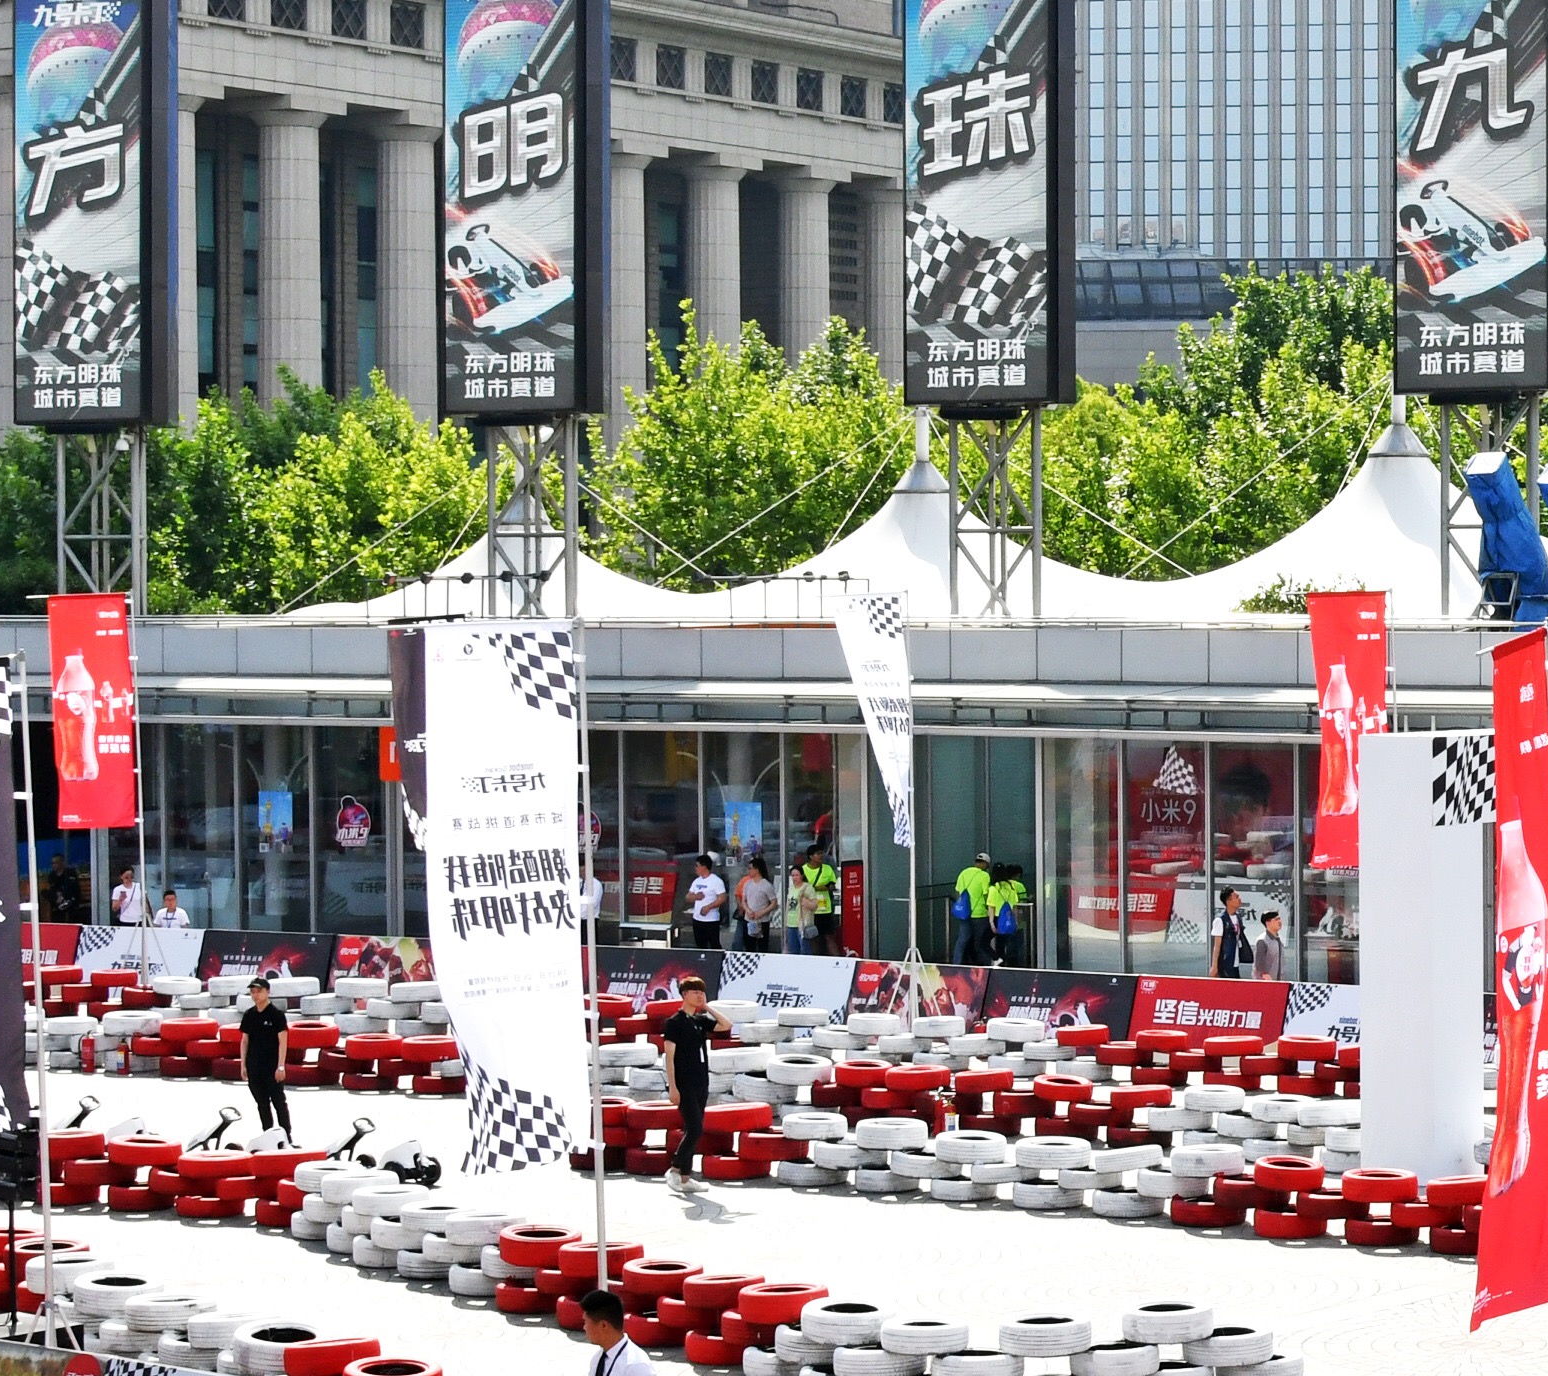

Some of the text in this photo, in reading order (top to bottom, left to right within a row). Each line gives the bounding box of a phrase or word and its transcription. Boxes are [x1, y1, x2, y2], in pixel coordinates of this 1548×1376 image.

[33, 3, 107, 27] 九号卡丁
[1417, 40, 1530, 152] 九
[923, 71, 1031, 176] 珠
[464, 92, 563, 198] 明
[29, 126, 124, 216] 方
[1419, 322, 1525, 347] 东方明珠
[927, 338, 1025, 362] 东方明珠
[34, 364, 122, 385] 东方明珠
[465, 352, 555, 373] 东方明珠
[1419, 350, 1525, 375] 城市赛道
[465, 376, 555, 398] 城市赛道
[927, 364, 1026, 387] 城市赛道
[34, 386, 122, 408] 城市赛道
[1141, 798, 1197, 824] 小米9
[756, 992, 804, 1008] 九号卡丁
[1153, 998, 1262, 1030] 坚信光明力量
